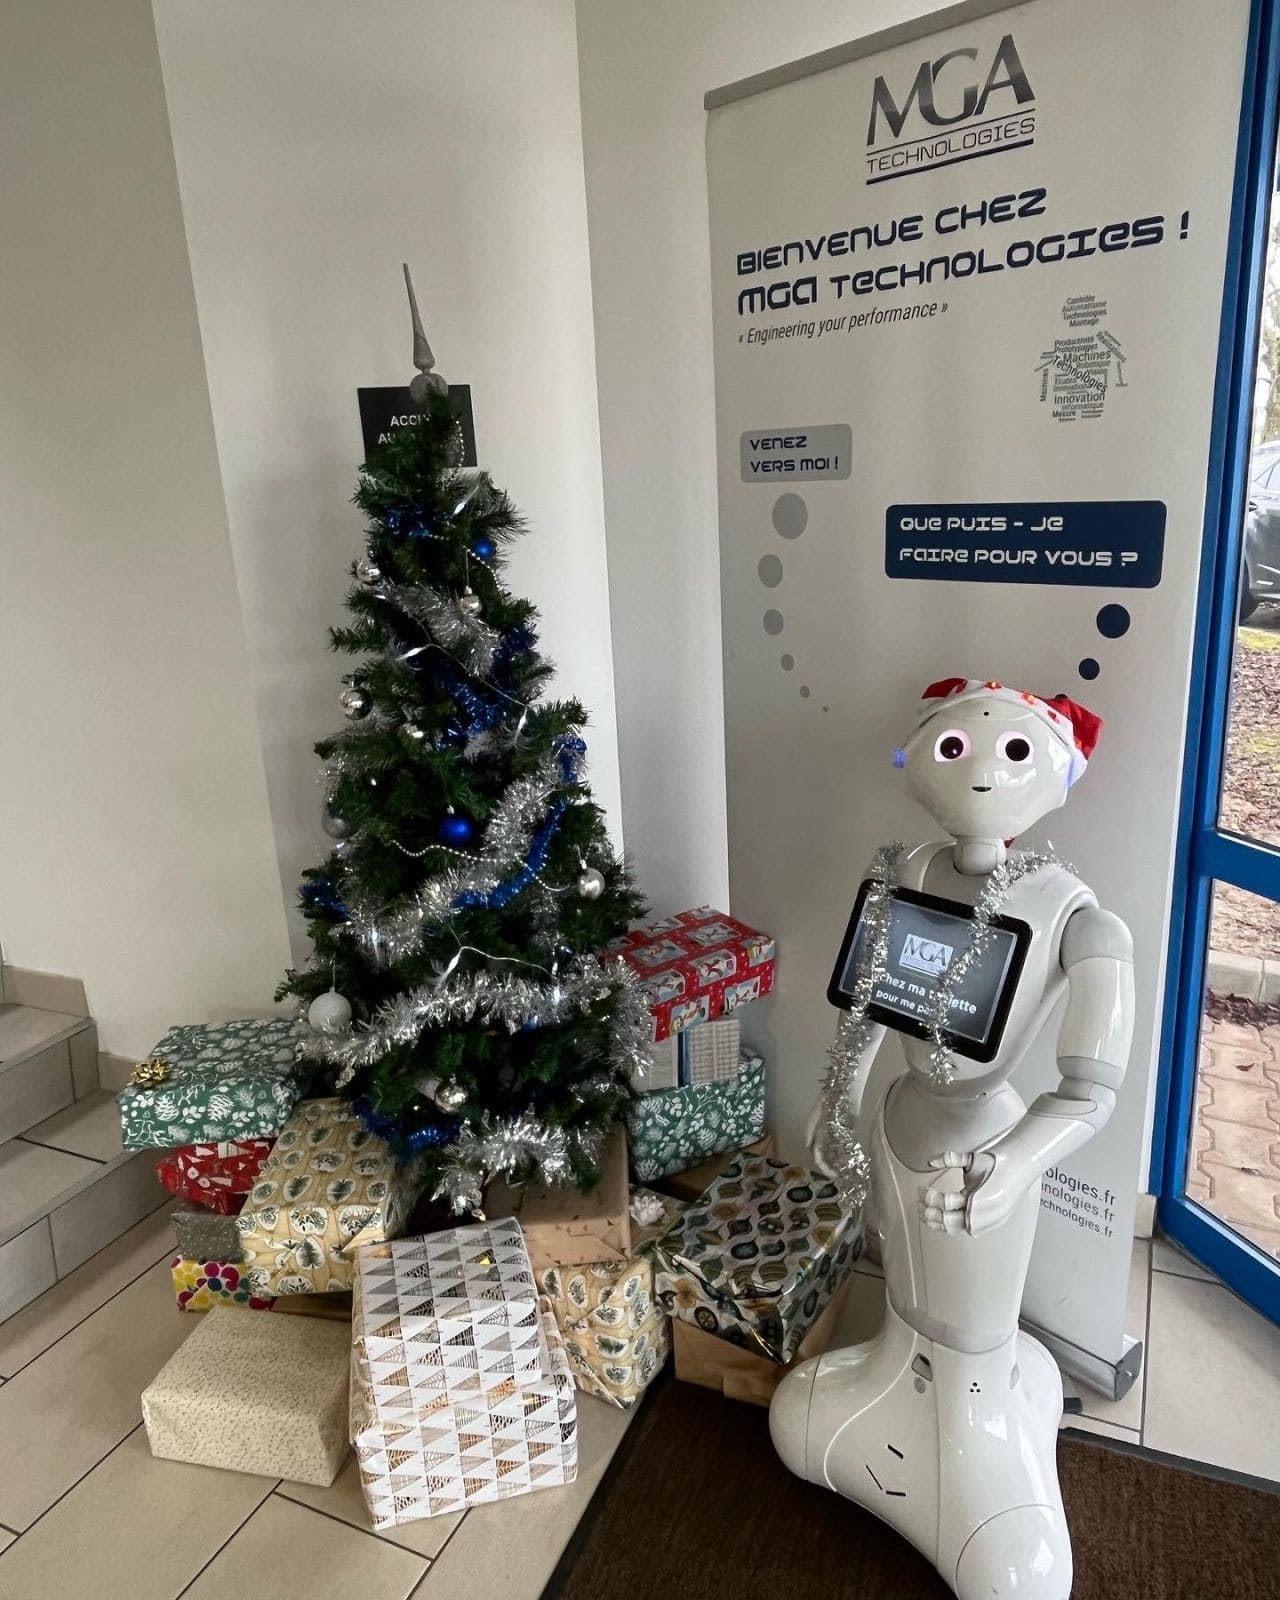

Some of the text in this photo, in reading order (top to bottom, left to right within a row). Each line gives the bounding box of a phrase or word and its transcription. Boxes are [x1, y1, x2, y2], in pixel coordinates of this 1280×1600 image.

[867, 33, 1036, 146] MGA
[867, 116, 1036, 173] TECHNOLOGIES
[737, 187, 1047, 275] BIENVENUE CHEZ
[738, 276, 818, 315] MGA
[1179, 211, 1190, 240] !
[747, 320, 816, 345] Engineering
[817, 316, 847, 337] your
[849, 302, 938, 332] performance
[1063, 350, 1112, 363] Machines
[1053, 355, 1108, 393] Technologies
[1054, 392, 1105, 404] Innovation
[749, 436, 807, 451] VENEZ
[750, 456, 838, 472] VERS MOI !
[900, 517, 942, 531] QUE
[947, 517, 998, 531] PUIS
[1031, 517, 1064, 531] JE
[899, 548, 1138, 566] FAIRE POUR VOUS ?
[904, 937, 947, 966] MGA
[876, 989, 916, 1010] pour me
[908, 982, 926, 997] ma
[1046, 1167, 1117, 1205] ologies.fr
